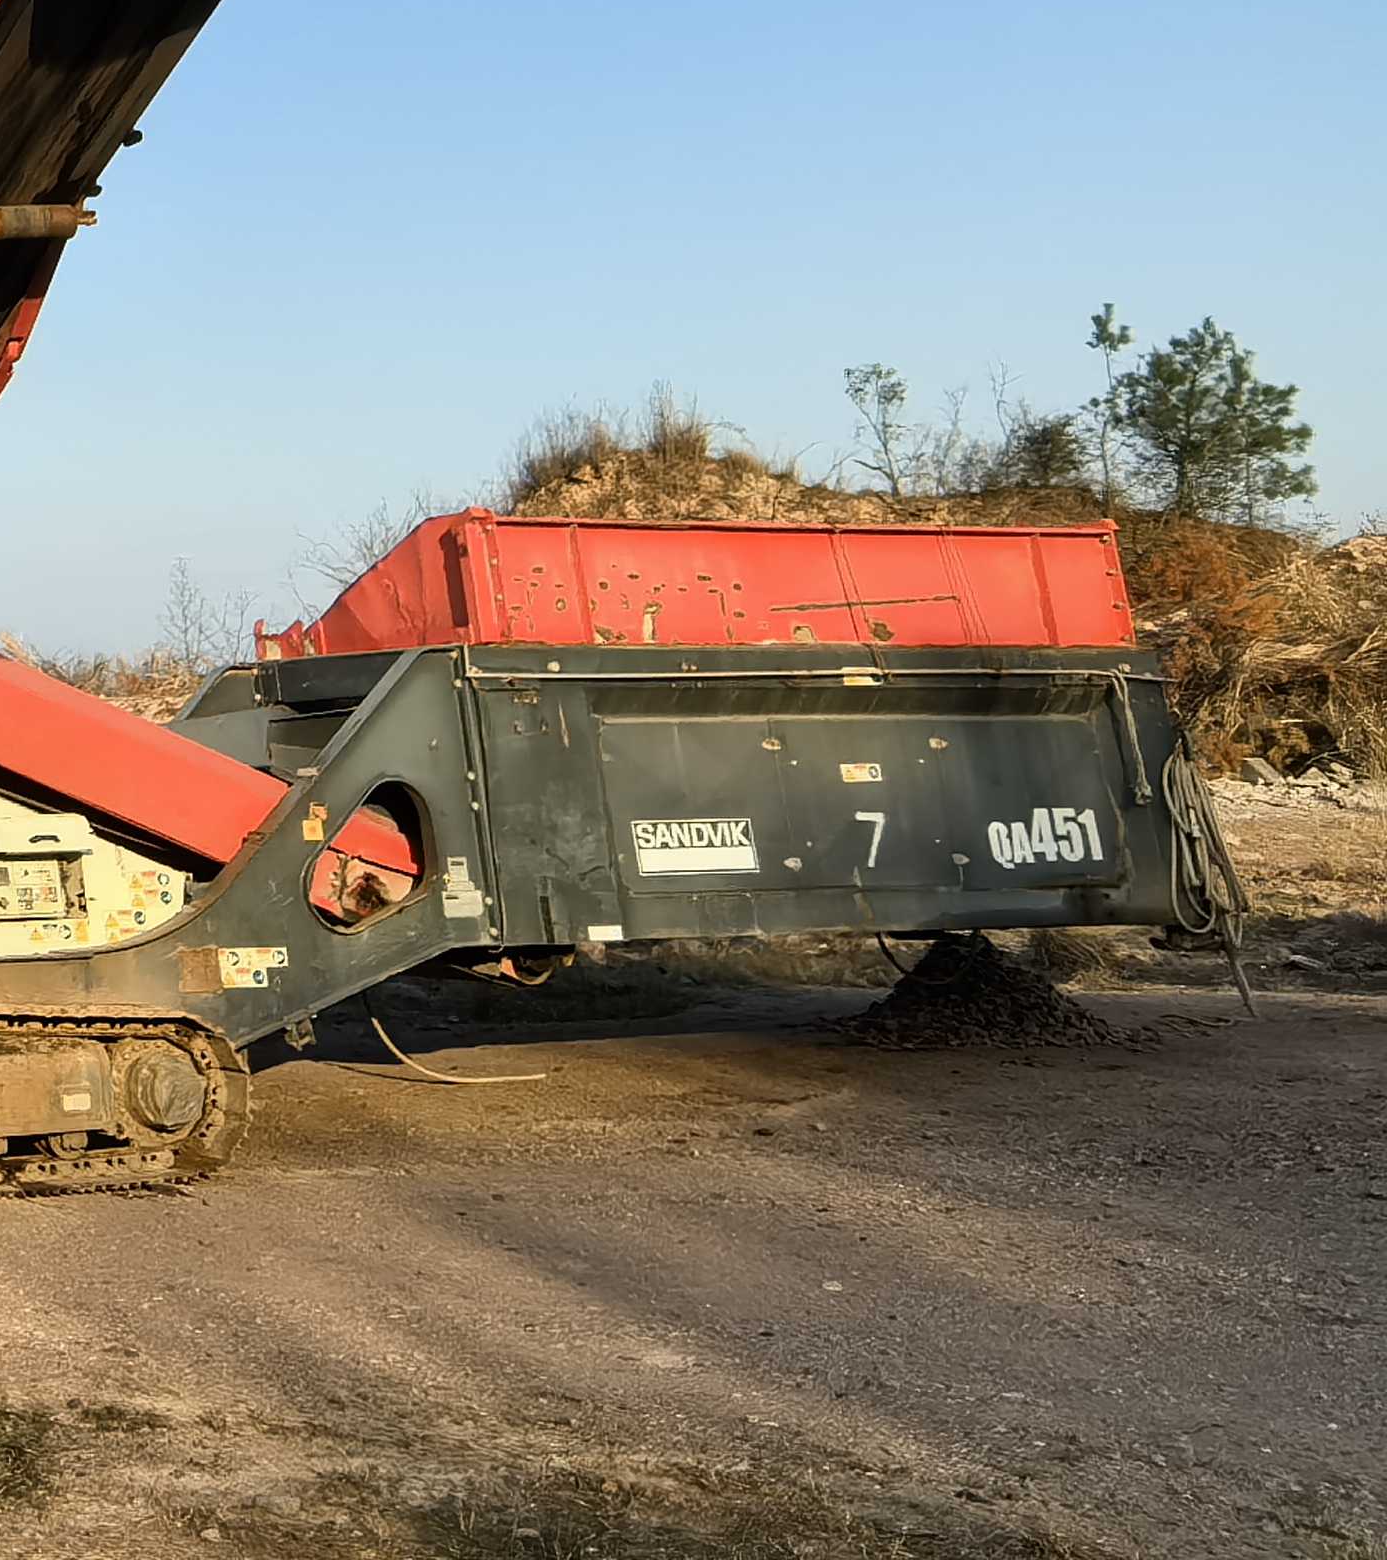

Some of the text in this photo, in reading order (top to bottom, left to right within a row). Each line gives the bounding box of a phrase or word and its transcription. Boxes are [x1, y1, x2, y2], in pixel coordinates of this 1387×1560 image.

[637, 822, 751, 849] SANDVIK
[854, 811, 885, 868] 7
[987, 807, 1104, 869] QA451
